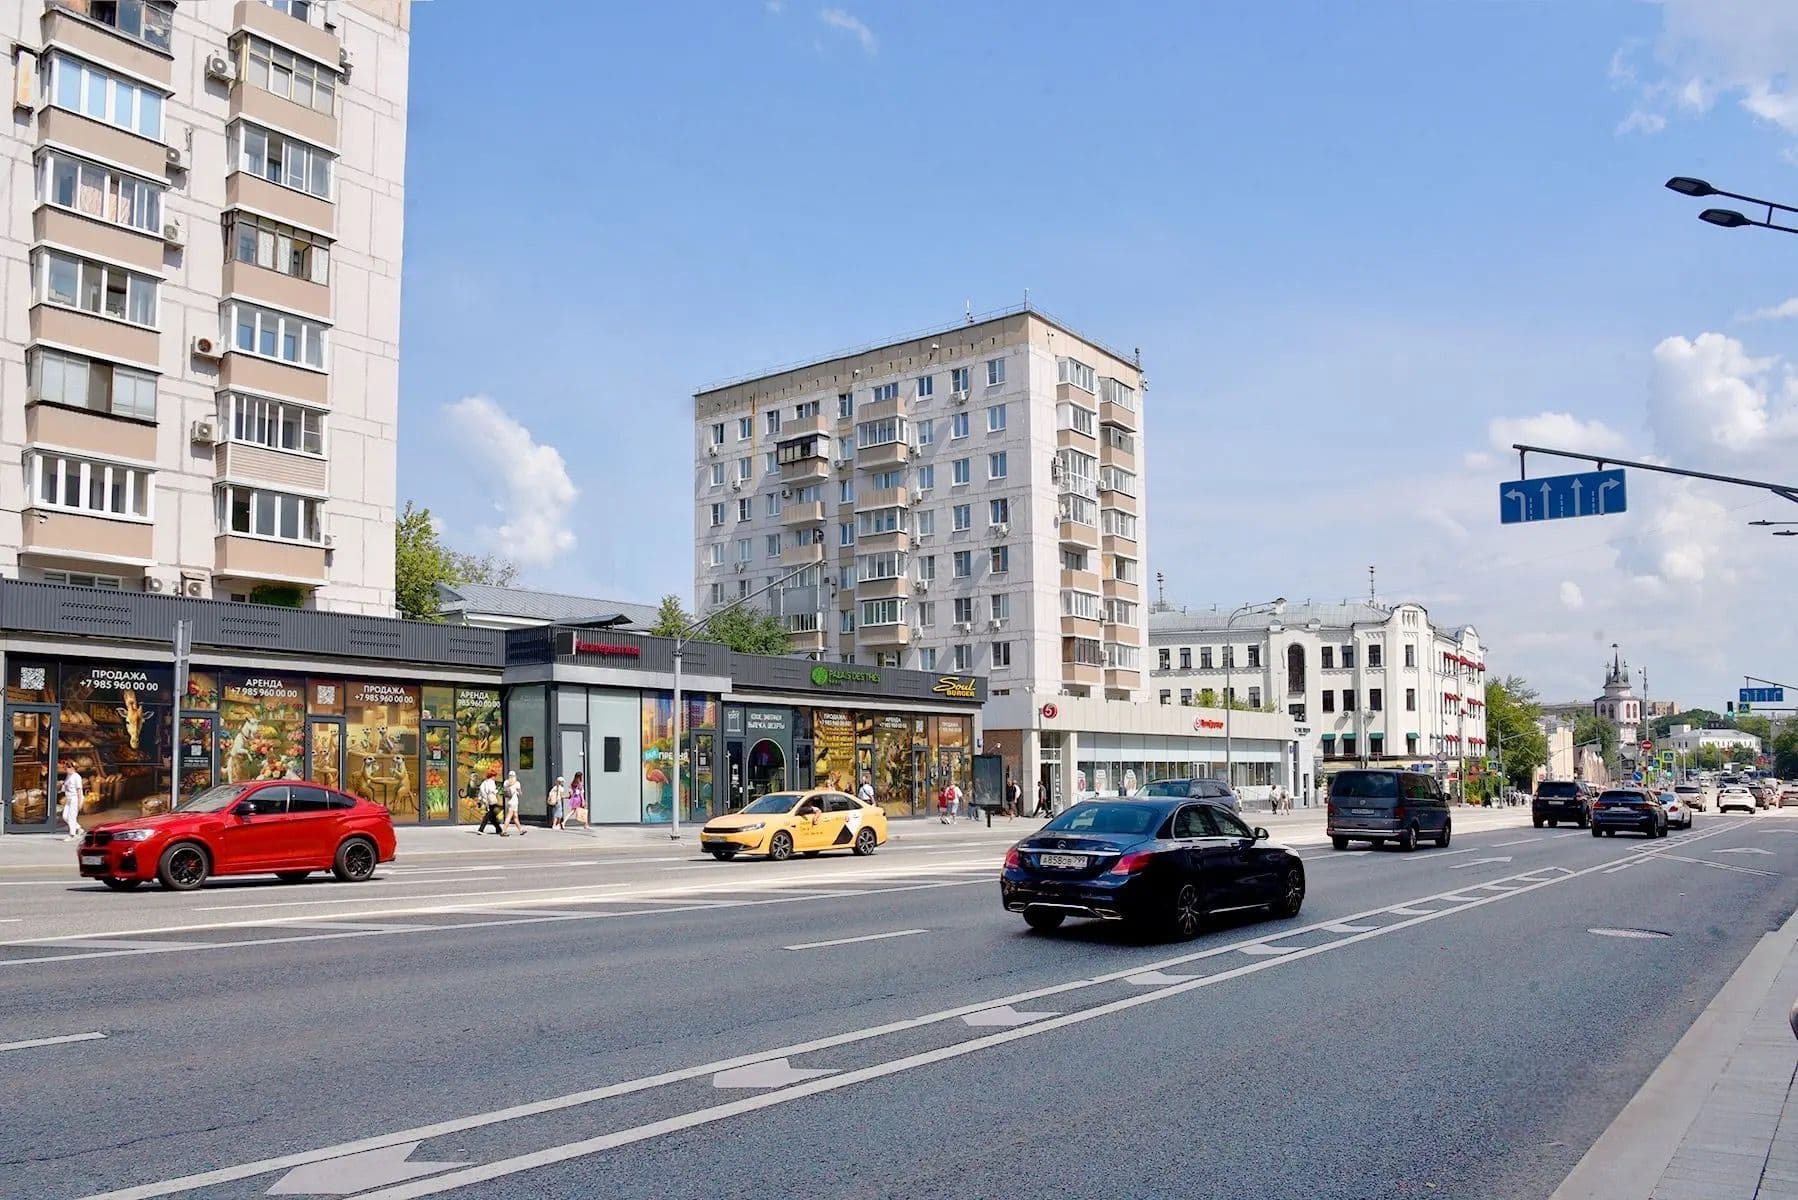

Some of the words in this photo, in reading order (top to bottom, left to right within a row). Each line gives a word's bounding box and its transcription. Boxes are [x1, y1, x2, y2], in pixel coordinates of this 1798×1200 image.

[91, 669, 148, 681] ПРОДАЖА
[80, 679, 92, 688] +7
[93, 680, 112, 689] 985
[113, 681, 132, 690] 960
[133, 682, 145, 691] 00
[146, 682, 159, 691] 00
[245, 679, 283, 689] АРЕНДА
[932, 676, 976, 691] Soul
[231, 687, 241, 695] +7
[242, 687, 258, 696] 985
[259, 689, 275, 697] 960
[287, 690, 297, 698] 00
[363, 685, 406, 695] ПРОДАЖА
[355, 693, 364, 701] +7
[365, 693, 379, 702] 985
[380, 694, 393, 703] 960
[394, 695, 403, 703] 00
[404, 695, 413, 703] 00
[460, 691, 490, 700] АРЕНДА
